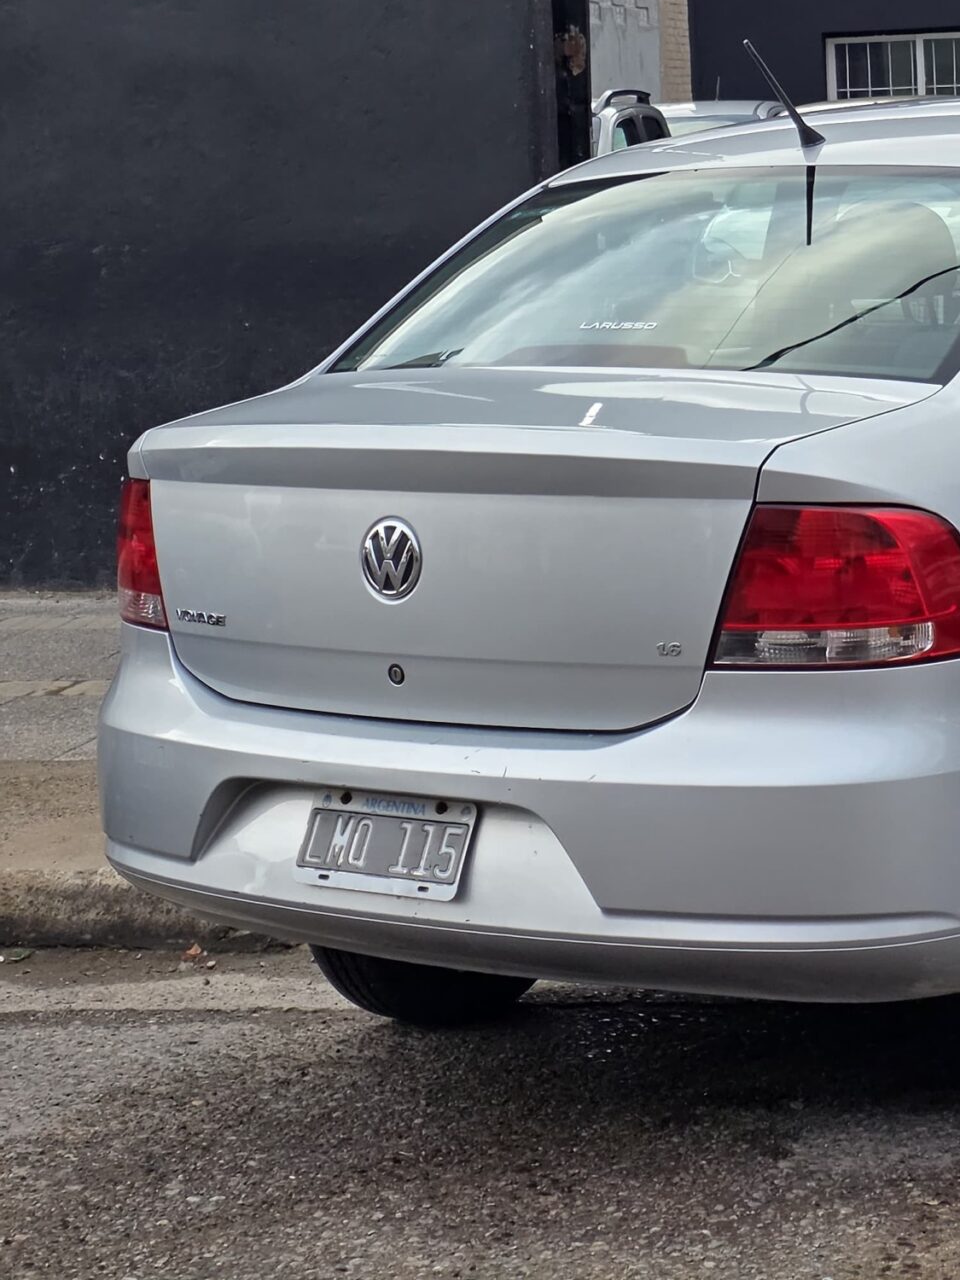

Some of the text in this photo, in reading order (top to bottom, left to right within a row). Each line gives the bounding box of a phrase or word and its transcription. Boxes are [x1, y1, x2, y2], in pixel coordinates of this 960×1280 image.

[579, 321, 658, 330] LARUSSO
[363, 518, 421, 596] VW
[176, 608, 227, 626] VOYAGE
[361, 797, 427, 817] ARGENTINA
[388, 822, 467, 880] 115
